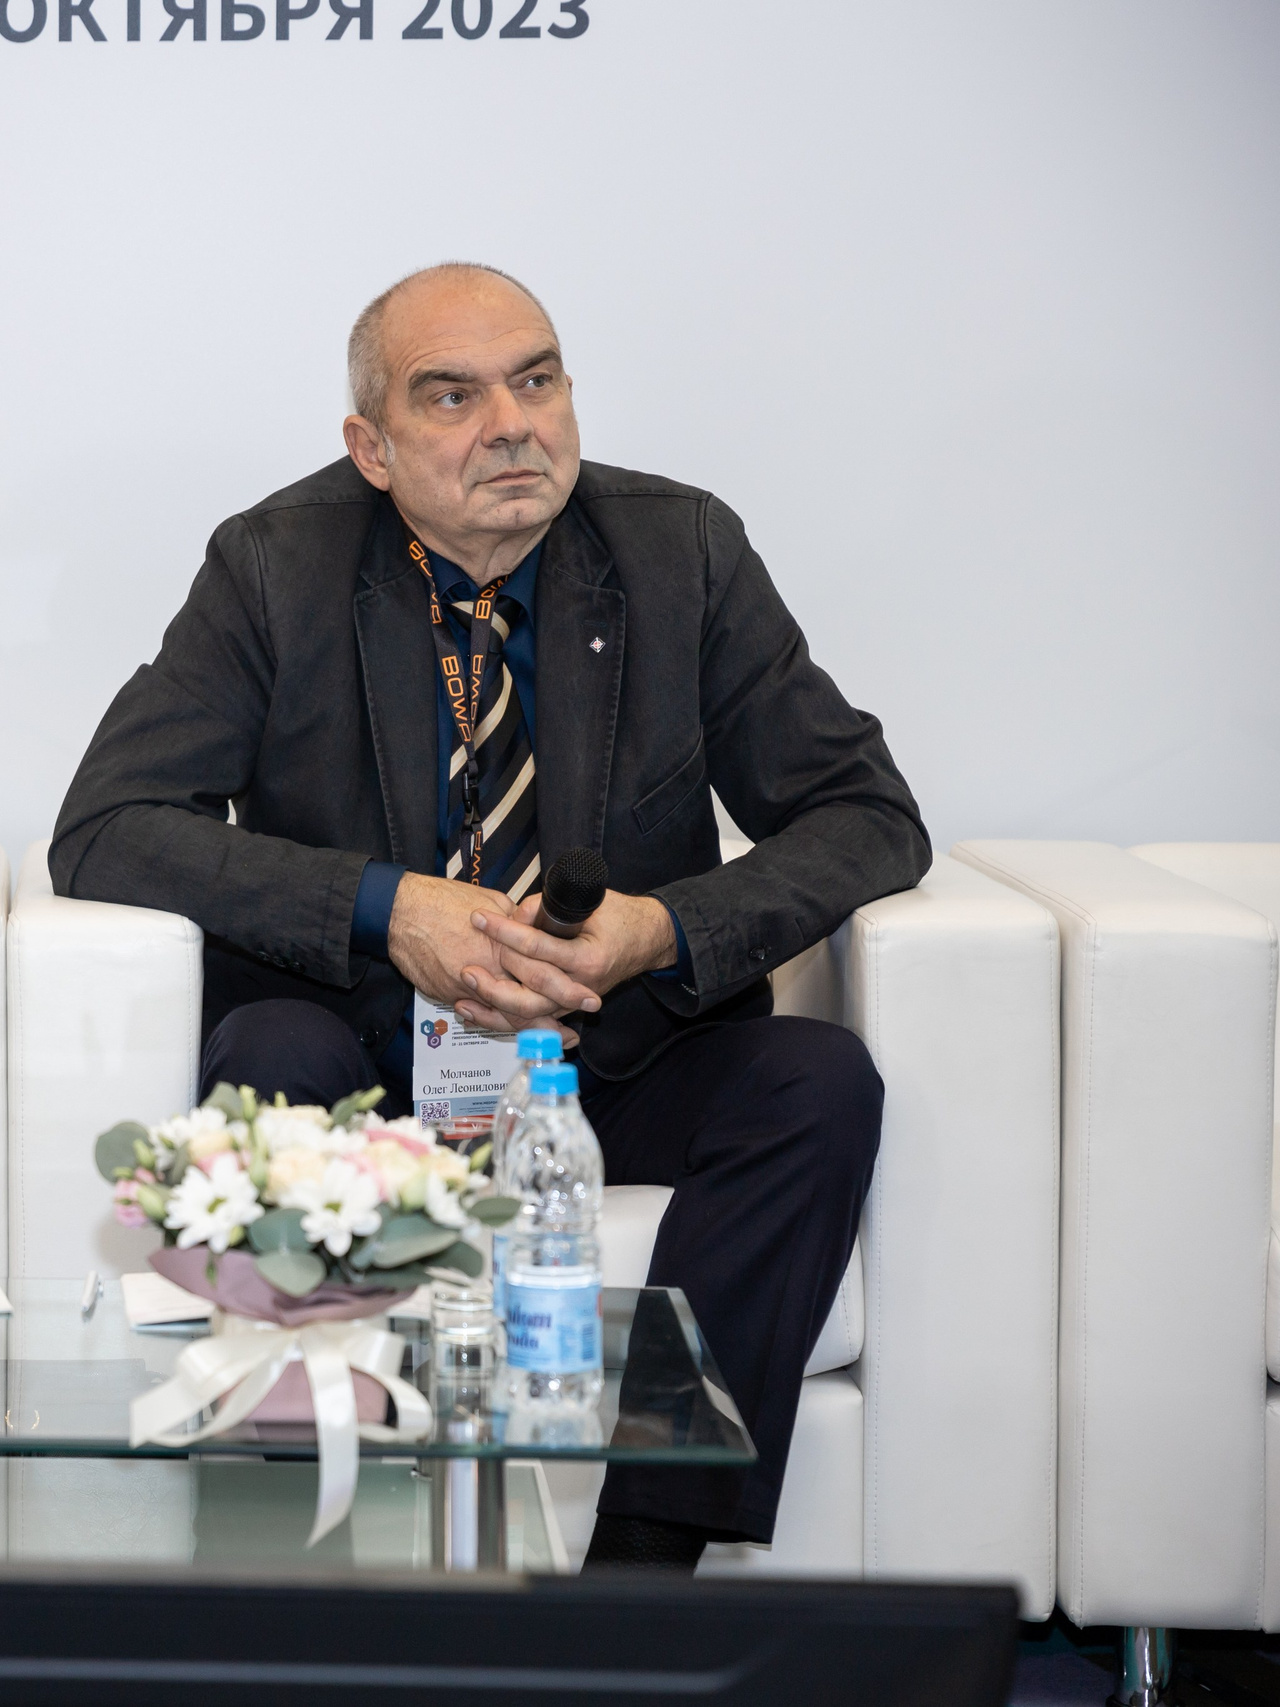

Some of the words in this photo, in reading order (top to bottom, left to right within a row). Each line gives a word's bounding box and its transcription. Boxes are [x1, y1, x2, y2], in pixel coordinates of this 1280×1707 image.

[401, 0, 590, 40] 2023
[442, 655, 471, 742] BOWA
[440, 1069, 491, 1079] Молчанов
[423, 1084, 447, 1095] Олег
